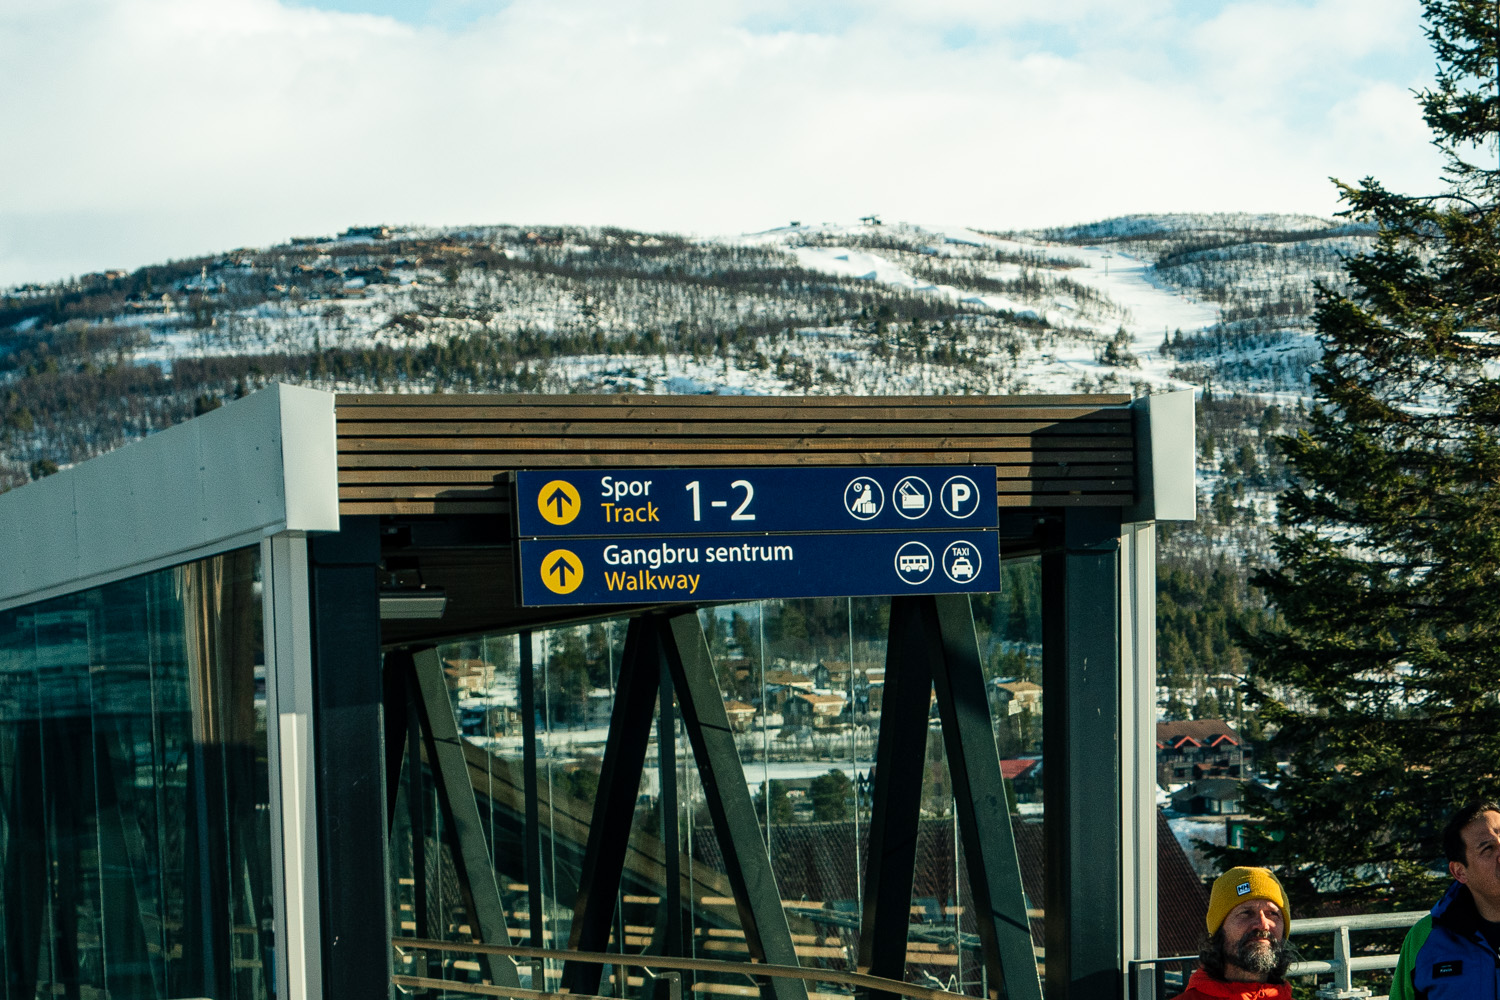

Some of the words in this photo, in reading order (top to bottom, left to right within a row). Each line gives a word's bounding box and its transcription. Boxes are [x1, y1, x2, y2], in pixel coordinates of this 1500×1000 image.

[601, 476, 652, 501] Spor
[685, 480, 756, 521] 1-2
[601, 502, 660, 523] Track
[603, 543, 699, 569] Gangbru
[705, 543, 793, 562] sentrum
[951, 547, 970, 557] TAXI
[605, 571, 701, 594] Walkway
